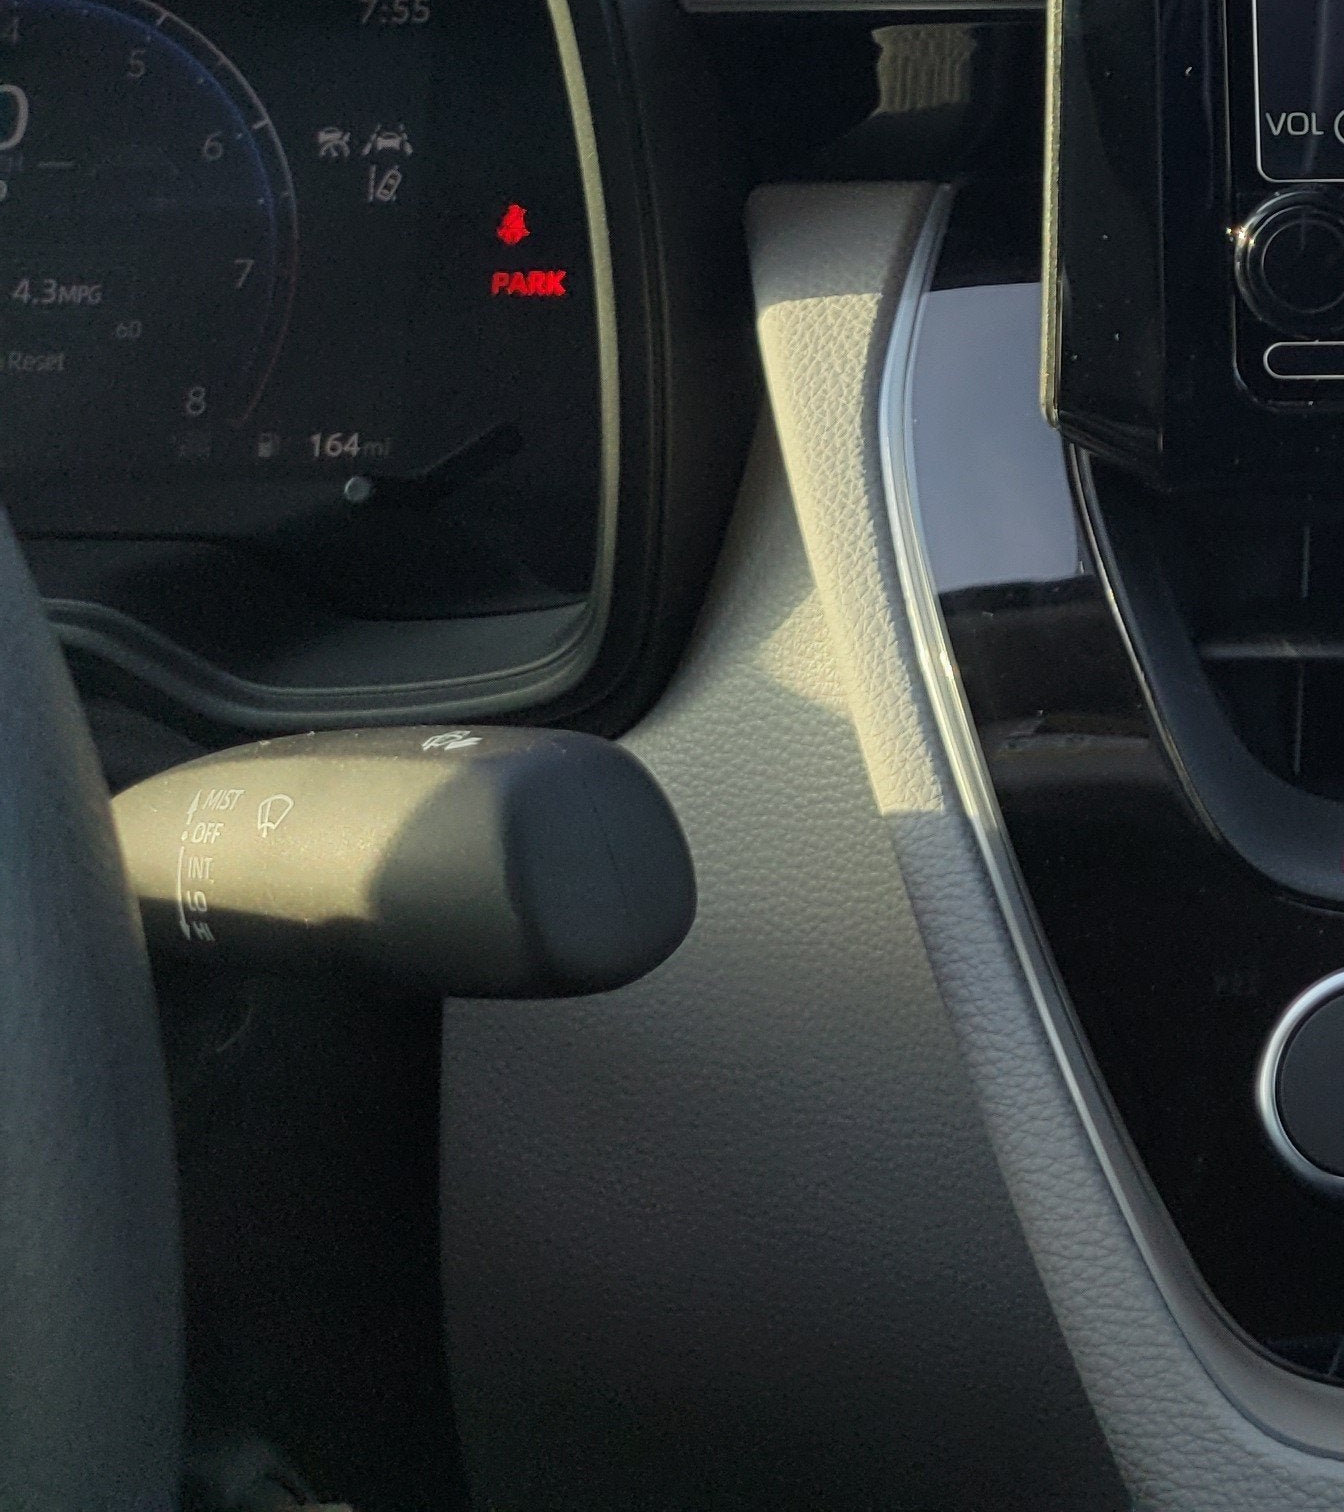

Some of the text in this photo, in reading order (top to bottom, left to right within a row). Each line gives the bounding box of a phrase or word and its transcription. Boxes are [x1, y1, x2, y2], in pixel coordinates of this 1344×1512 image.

[127, 49, 146, 79] 5
[1265, 112, 1325, 136] VOL
[204, 131, 224, 162] 6
[234, 259, 255, 289] 7
[492, 270, 567, 297] PARK
[187, 386, 206, 417] 8
[202, 788, 247, 811] MIST
[191, 822, 225, 845] OFF
